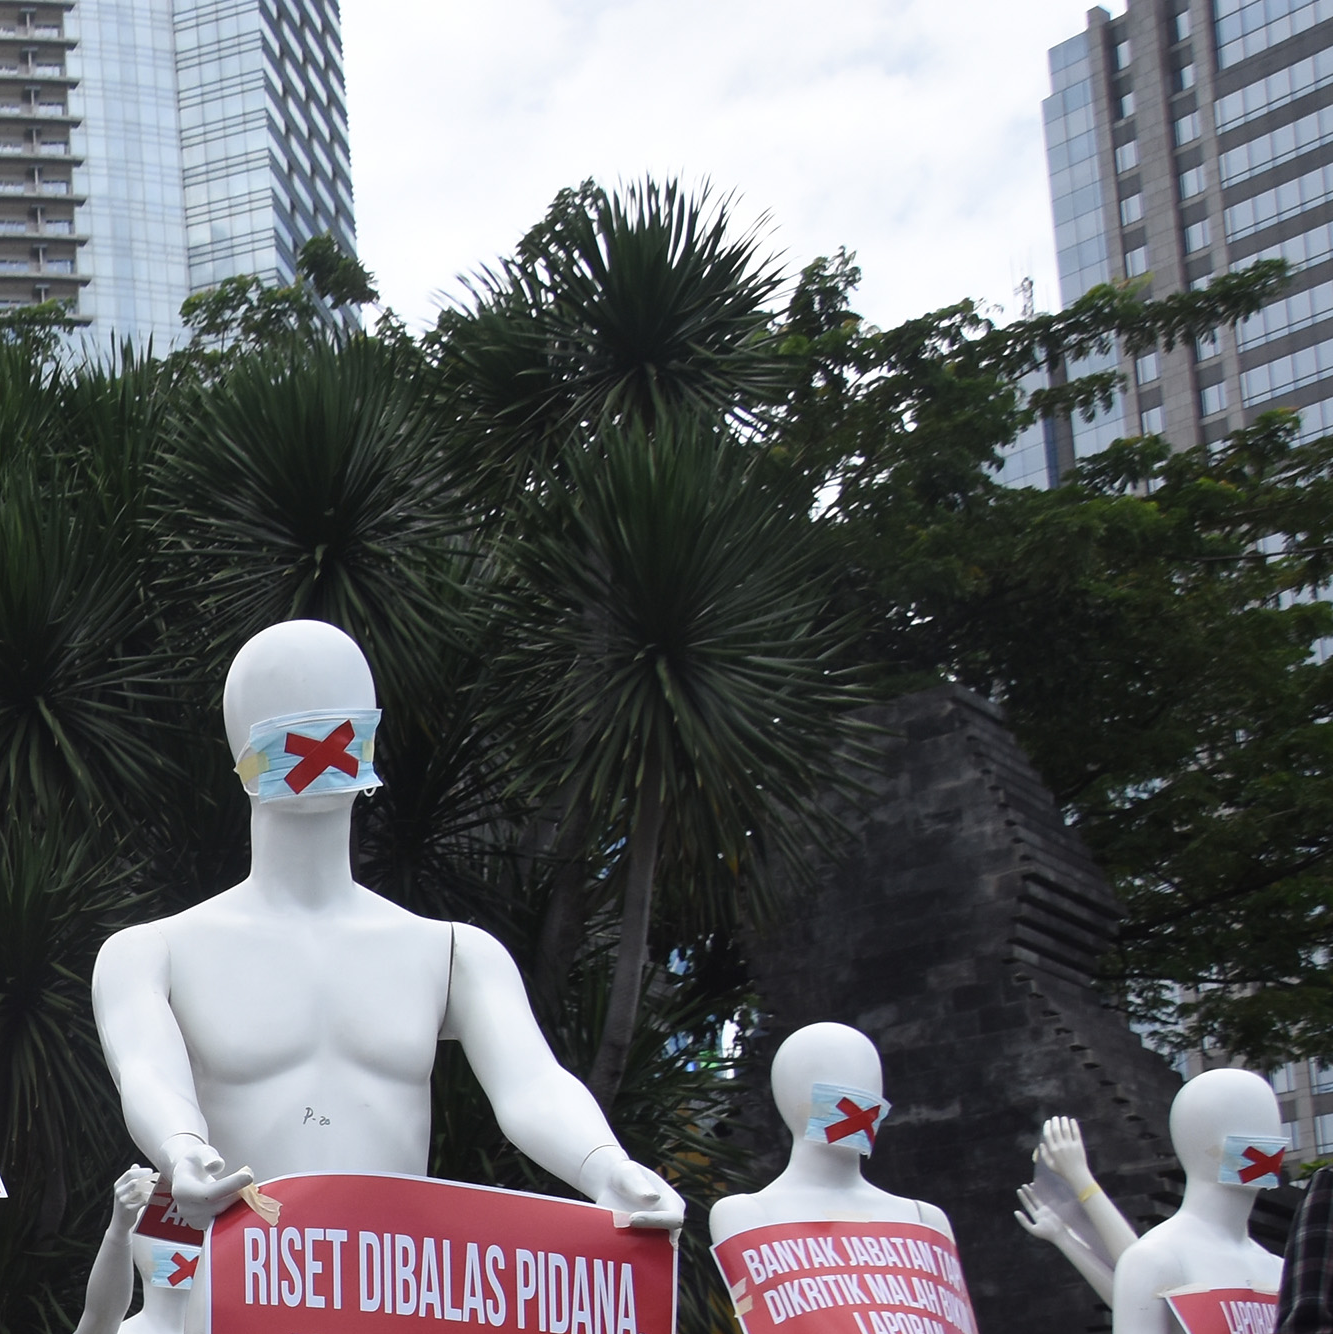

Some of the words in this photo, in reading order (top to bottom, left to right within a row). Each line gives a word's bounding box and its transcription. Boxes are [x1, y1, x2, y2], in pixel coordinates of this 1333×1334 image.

[243, 1226, 349, 1309] RISET
[358, 1230, 507, 1327] DIBALAS
[742, 1237, 845, 1285] BANYAK
[841, 1236, 939, 1276] JABATAN
[763, 1273, 870, 1325] DIKRITIK
[864, 1274, 943, 1317] MALAH
